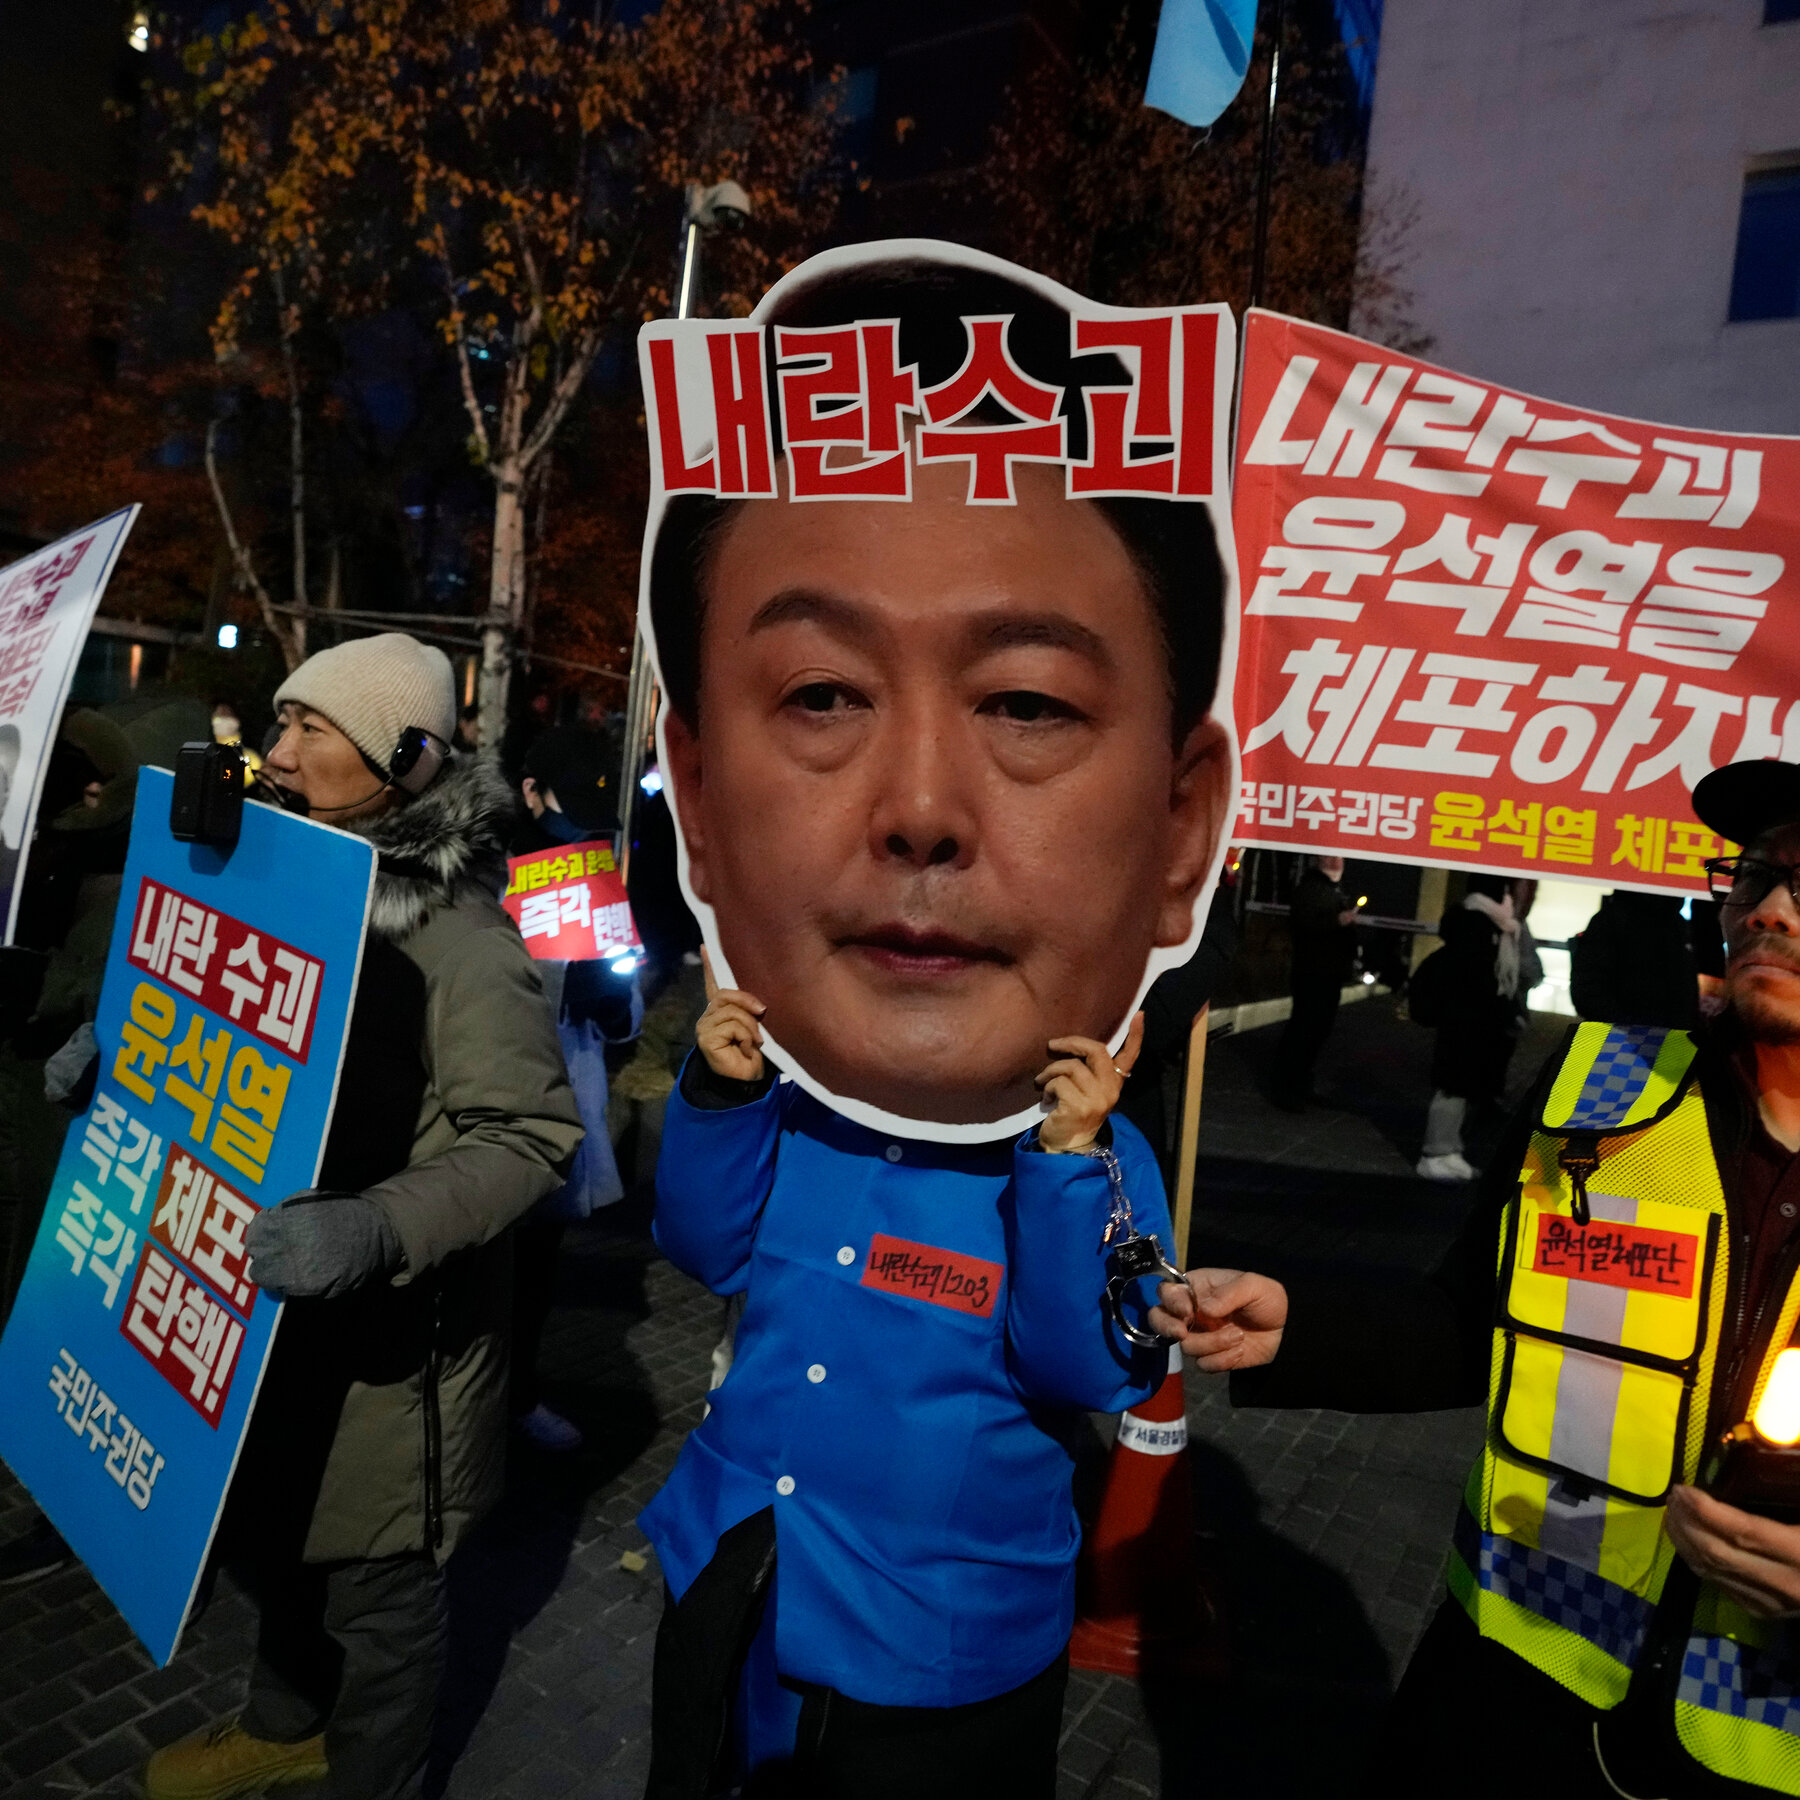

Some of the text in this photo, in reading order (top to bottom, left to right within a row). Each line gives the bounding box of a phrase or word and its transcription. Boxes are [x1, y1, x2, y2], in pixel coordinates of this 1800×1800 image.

[646, 313, 1221, 505] 내란수괴
[1242, 354, 1764, 530] 내란수괴
[0, 534, 97, 607] 란수괴
[1243, 496, 1785, 671] 윤석열을
[505, 852, 585, 897] 내란수괴
[520, 883, 592, 939] 즉각
[1430, 791, 1598, 866] 윤석열
[1611, 813, 1744, 879] 체포
[132, 886, 321, 1054] 내란 수괴
[82, 1092, 162, 1216] 즉각
[112, 982, 293, 1185] 윤석열
[56, 1180, 244, 1414] 즉각 탄핵!
[49, 1348, 165, 1511] 국민주권당
